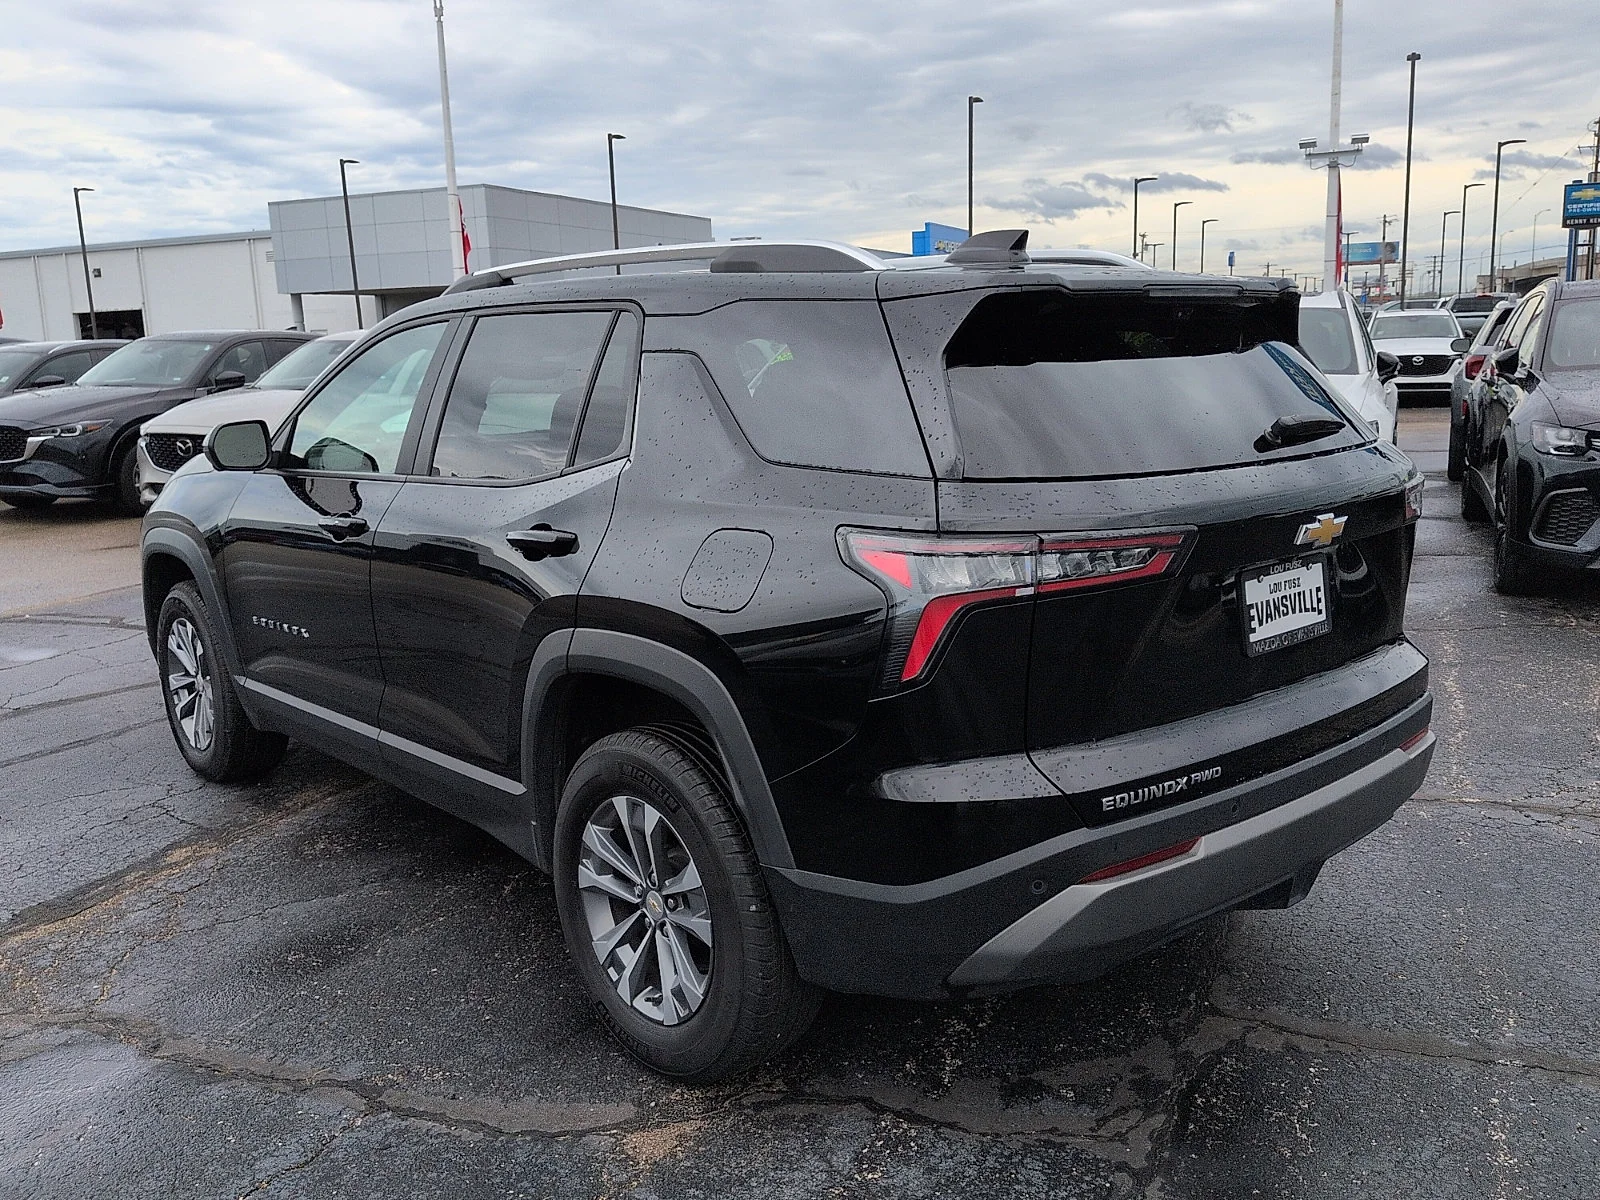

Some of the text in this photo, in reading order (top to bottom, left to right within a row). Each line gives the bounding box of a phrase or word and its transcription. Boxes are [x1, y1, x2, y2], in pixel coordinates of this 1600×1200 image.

[1270, 559, 1302, 574] LOU FUSZ
[1268, 577, 1301, 594] LOU FUSZ
[1247, 586, 1323, 633] EVANSVILLE
[1252, 637, 1281, 654] MAZDA
[1101, 766, 1222, 812] EQUINOX AWD
